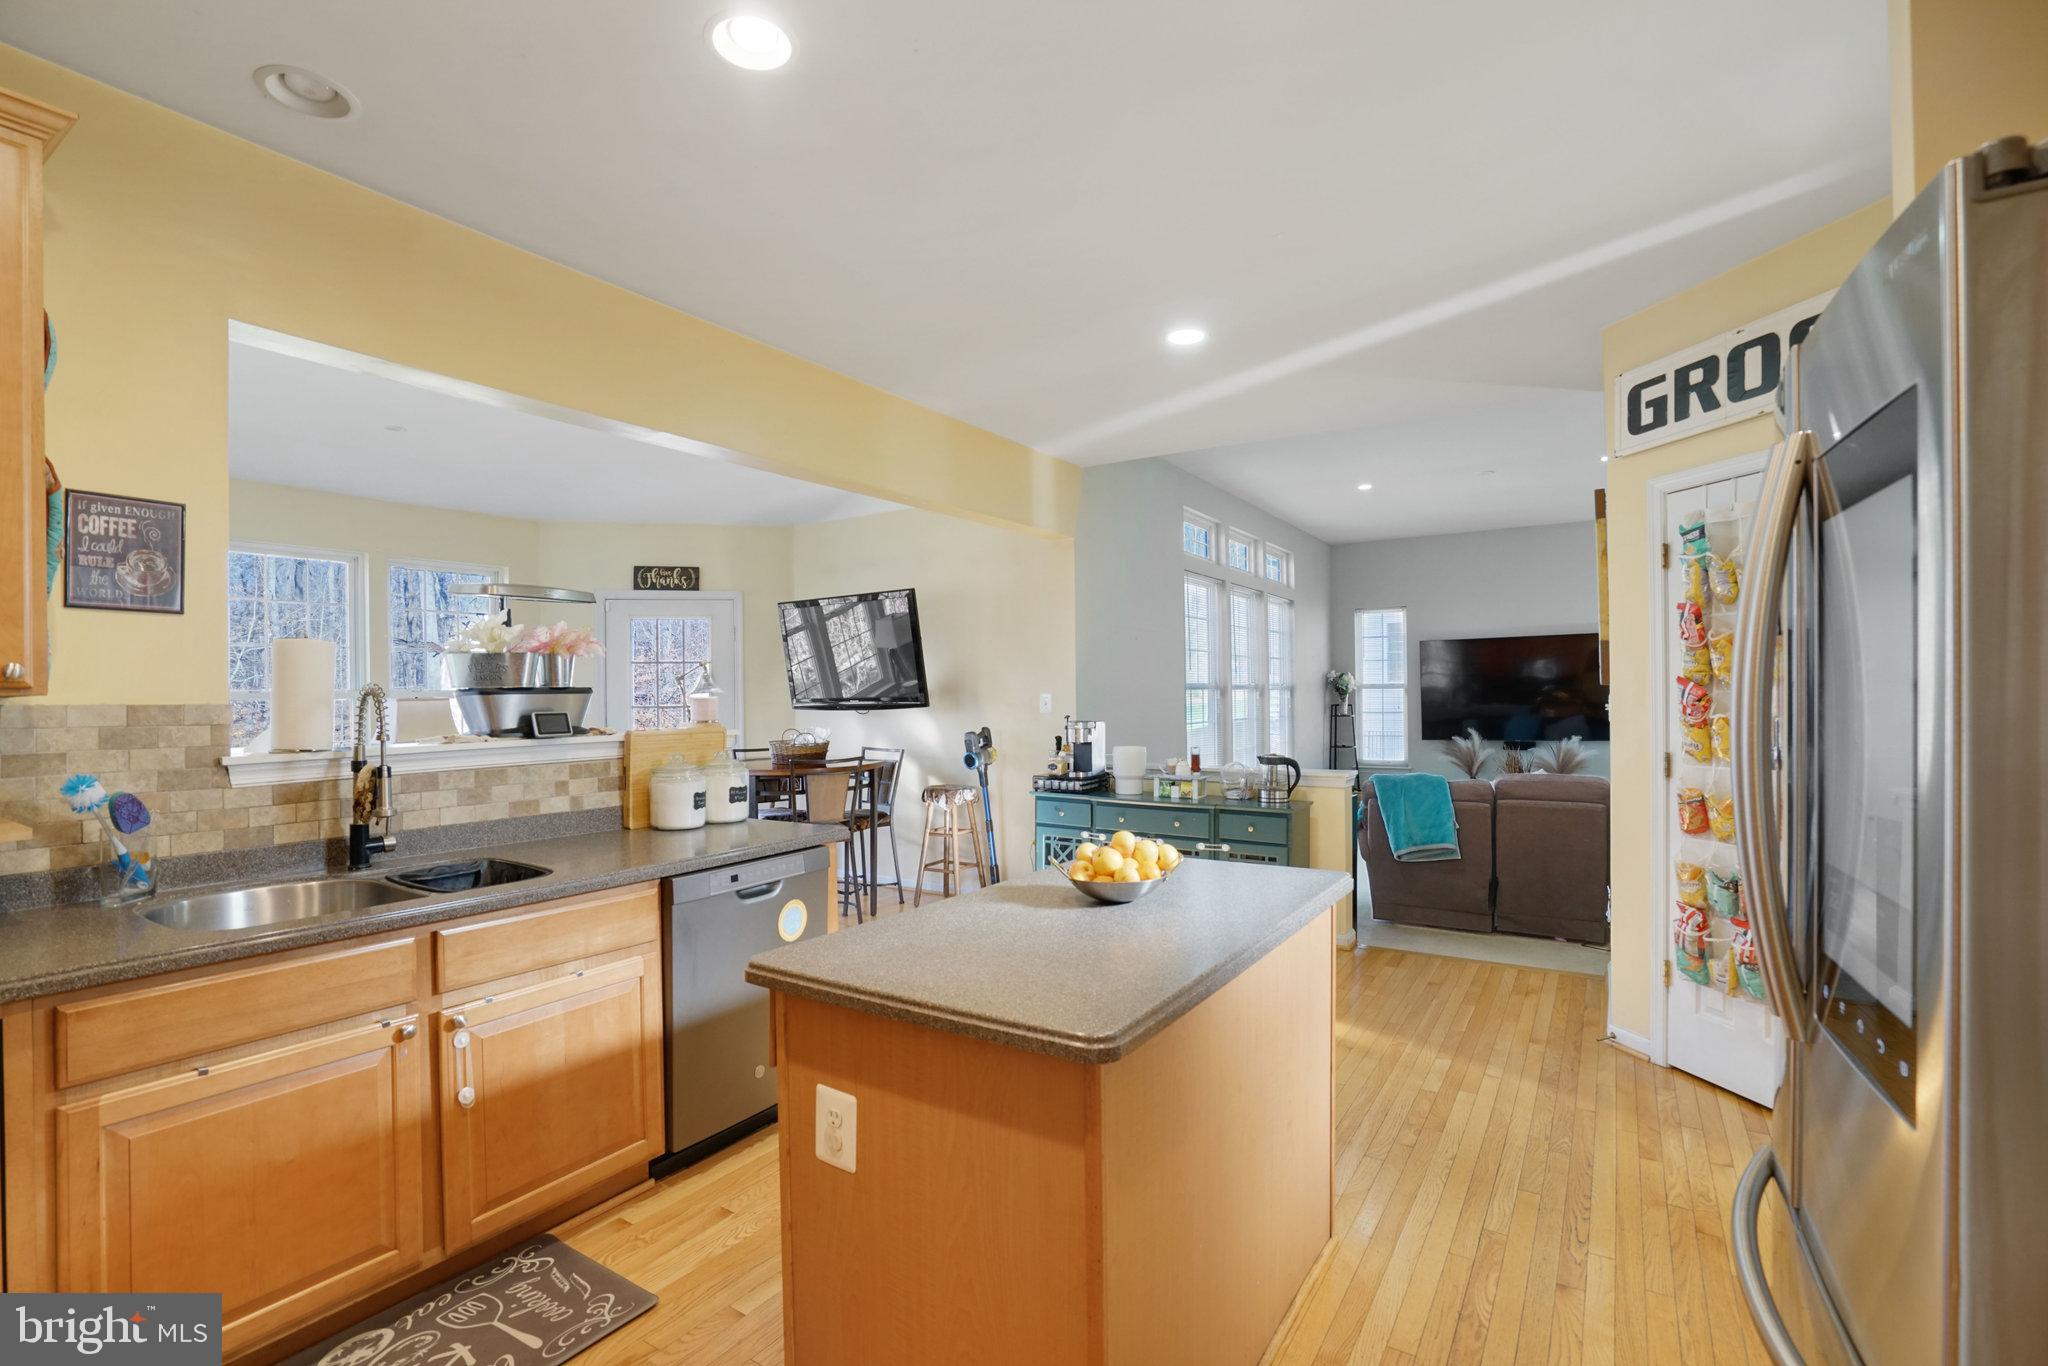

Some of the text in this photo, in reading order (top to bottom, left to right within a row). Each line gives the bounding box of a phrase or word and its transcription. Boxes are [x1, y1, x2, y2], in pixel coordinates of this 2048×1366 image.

[1627, 313, 1822, 435] GRO
[90, 502, 121, 514] given
[125, 506, 175, 519] ENOUGH
[78, 513, 137, 539] COFFEE
[91, 538, 124, 554] could
[78, 554, 115, 568] RULE
[89, 569, 109, 585] the
[643, 568, 689, 588] Thanks
[505, 1276, 574, 1322] cooking
